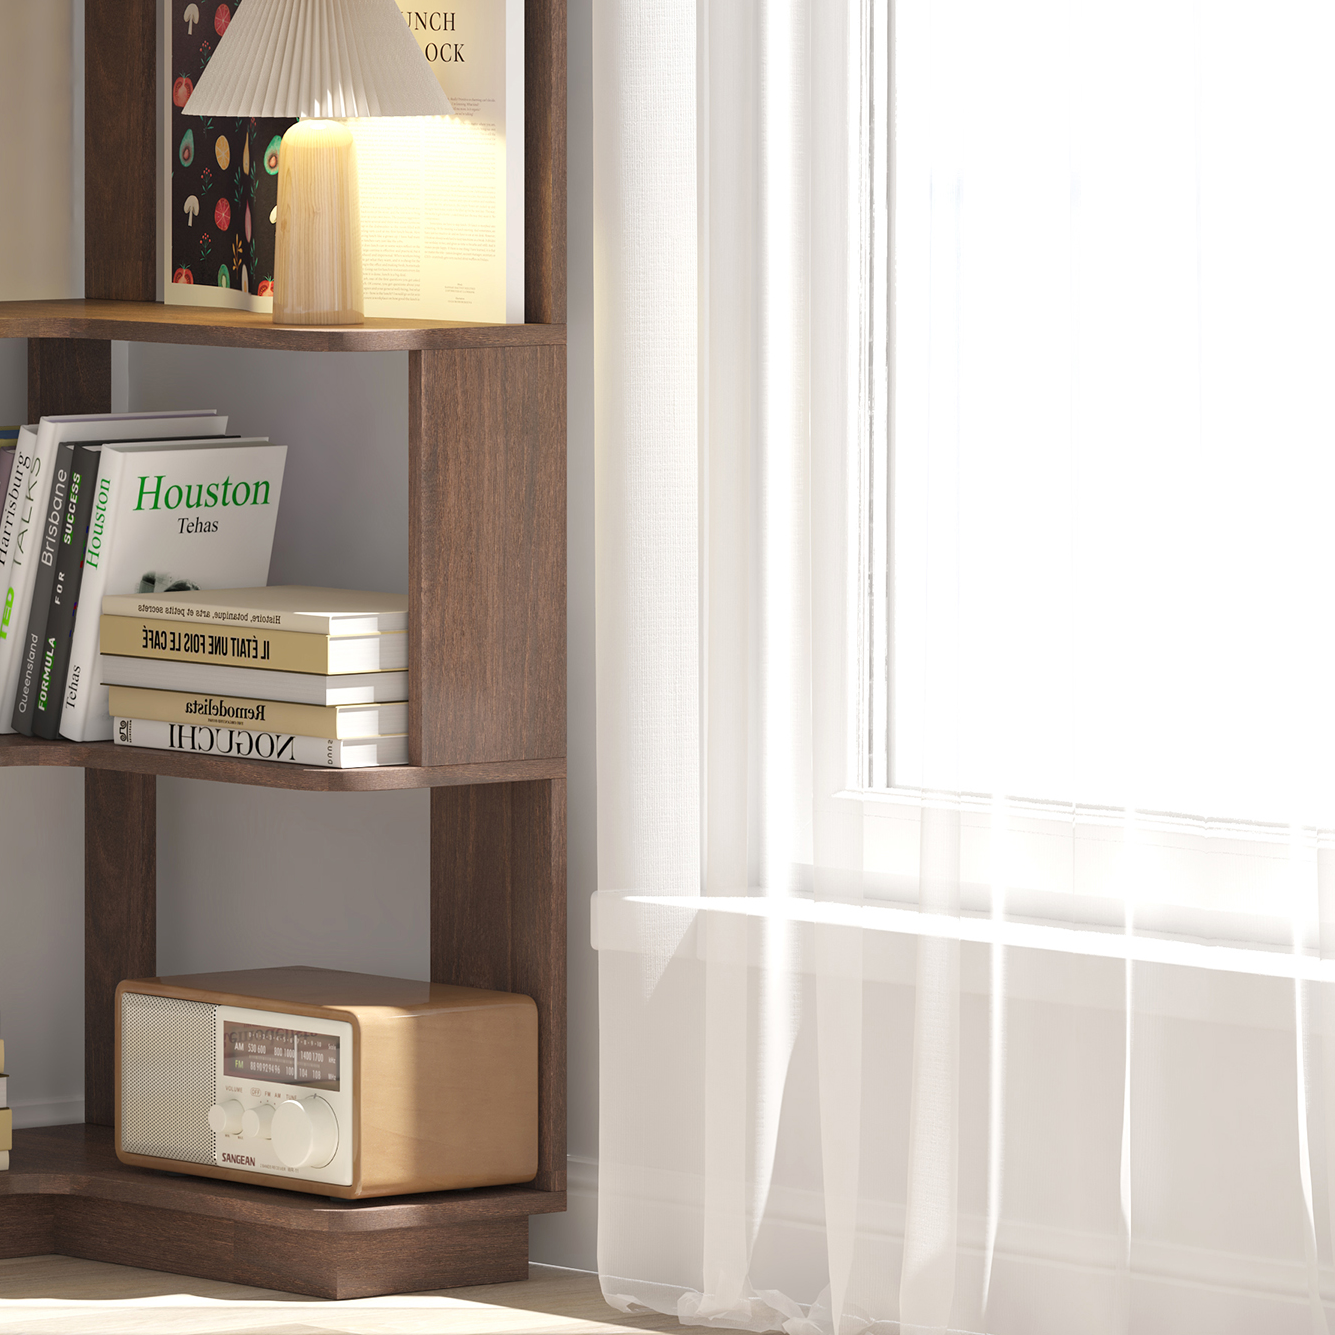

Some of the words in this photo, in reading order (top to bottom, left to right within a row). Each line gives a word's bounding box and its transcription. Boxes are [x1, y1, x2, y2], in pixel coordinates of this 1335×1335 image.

[425, 42, 465, 63] OCK
[132, 475, 270, 511] Houston
[178, 516, 219, 534] Tehas
[19, 633, 39, 713] Queensland
[41, 469, 67, 566] Brisbane
[38, 637, 57, 711] FORMULA
[54, 571, 65, 605] FOR
[63, 472, 82, 545] SUCCESS
[66, 665, 82, 708] Tehas
[86, 478, 111, 570] Houston
[234, 1042, 244, 1051] AM
[234, 1060, 244, 1069] FM
[225, 1085, 243, 1093] VOLUME
[221, 1152, 256, 1167] SANGEAN
